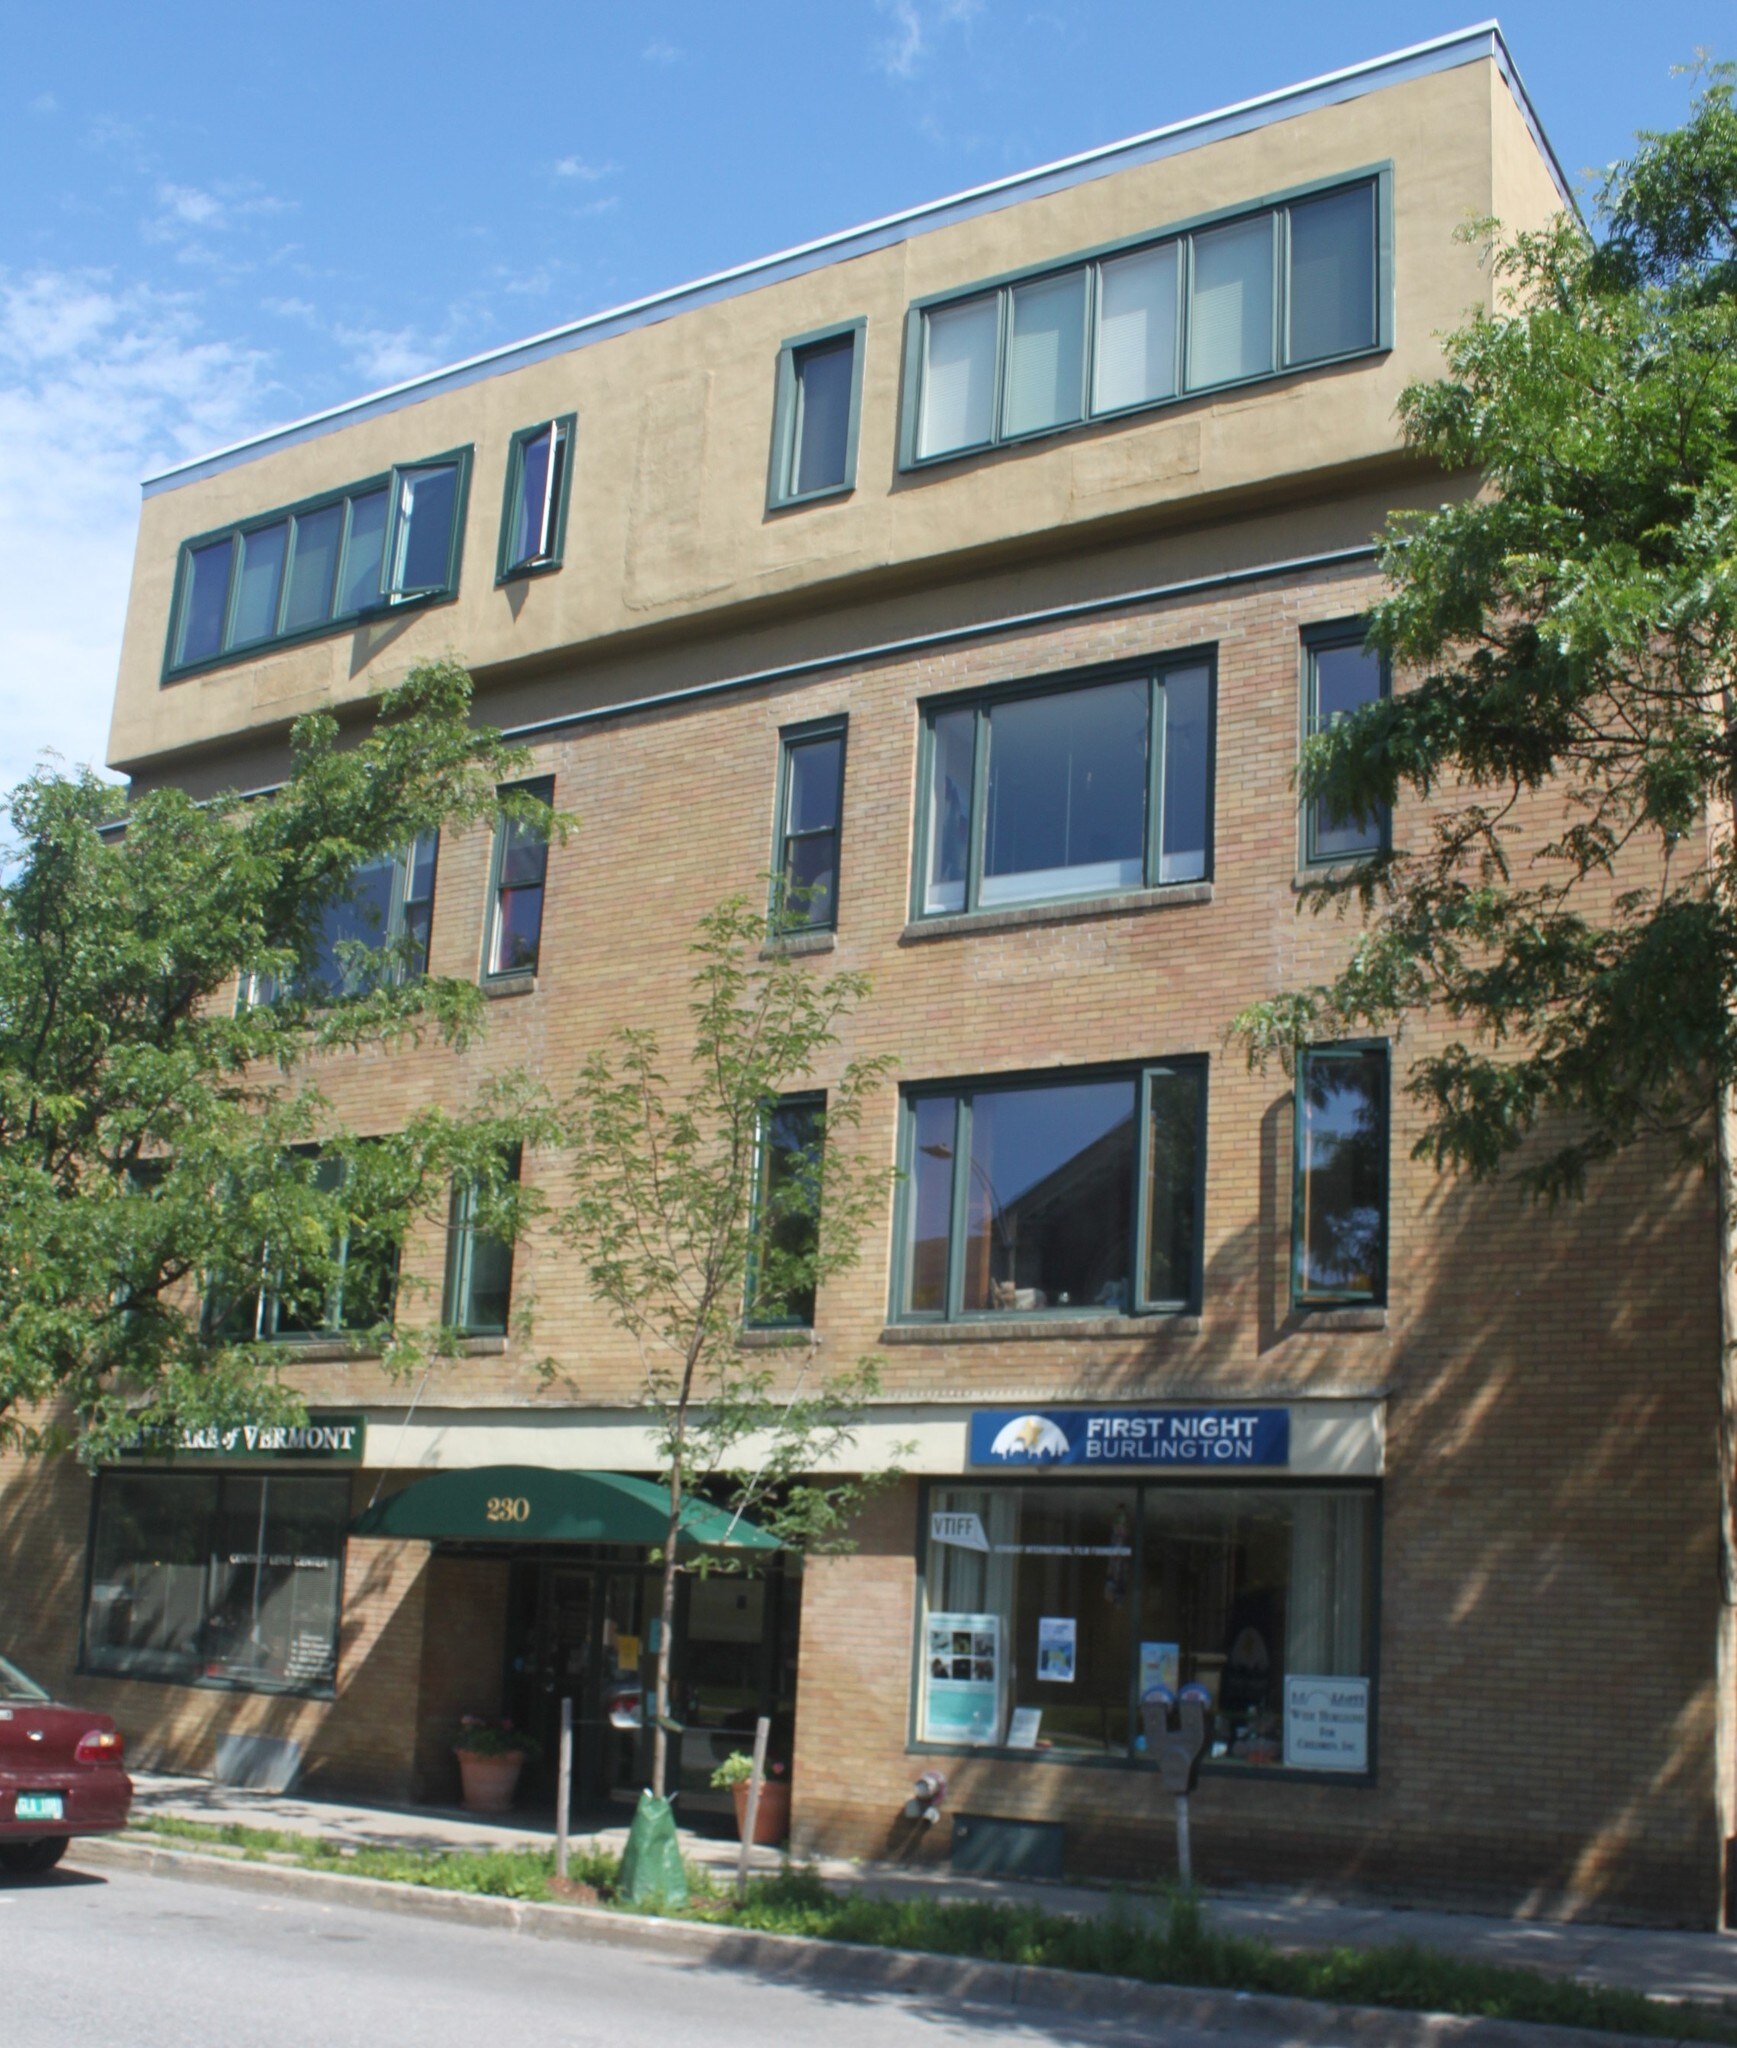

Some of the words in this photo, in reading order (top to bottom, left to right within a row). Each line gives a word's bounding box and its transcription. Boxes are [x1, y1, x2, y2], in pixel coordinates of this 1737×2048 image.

[222, 1427, 241, 1450] of
[243, 1425, 356, 1450] VERMONT
[1087, 1418, 1164, 1438] FIRST
[1171, 1417, 1259, 1438] NIGHT
[1086, 1440, 1253, 1458] BURLINGTON
[486, 1497, 530, 1521] 230
[933, 1517, 974, 1536] VTIFF
